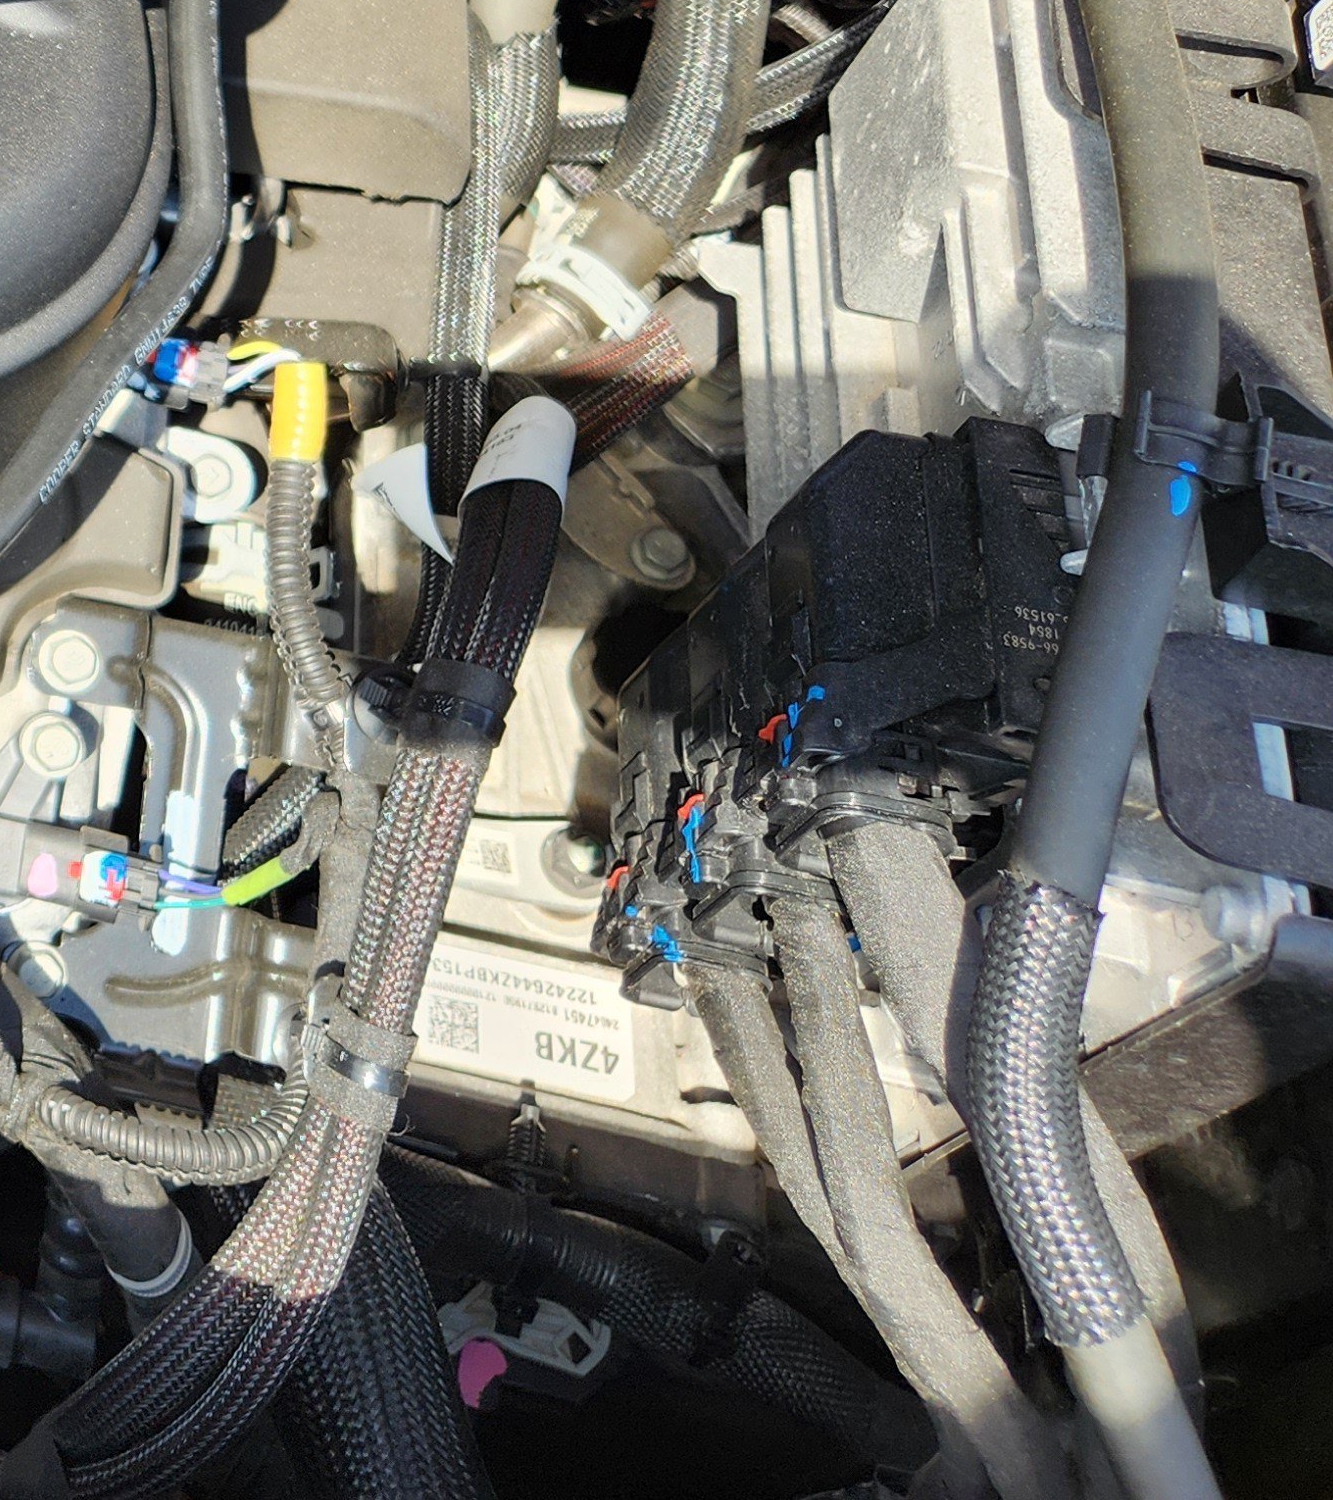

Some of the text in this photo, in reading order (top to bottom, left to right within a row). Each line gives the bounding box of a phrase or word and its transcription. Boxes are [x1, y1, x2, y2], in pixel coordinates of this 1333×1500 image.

[1028, 622, 1058, 639] 1854
[1002, 633, 1059, 655] 66-9583
[533, 1029, 619, 1075] 4ZKB
